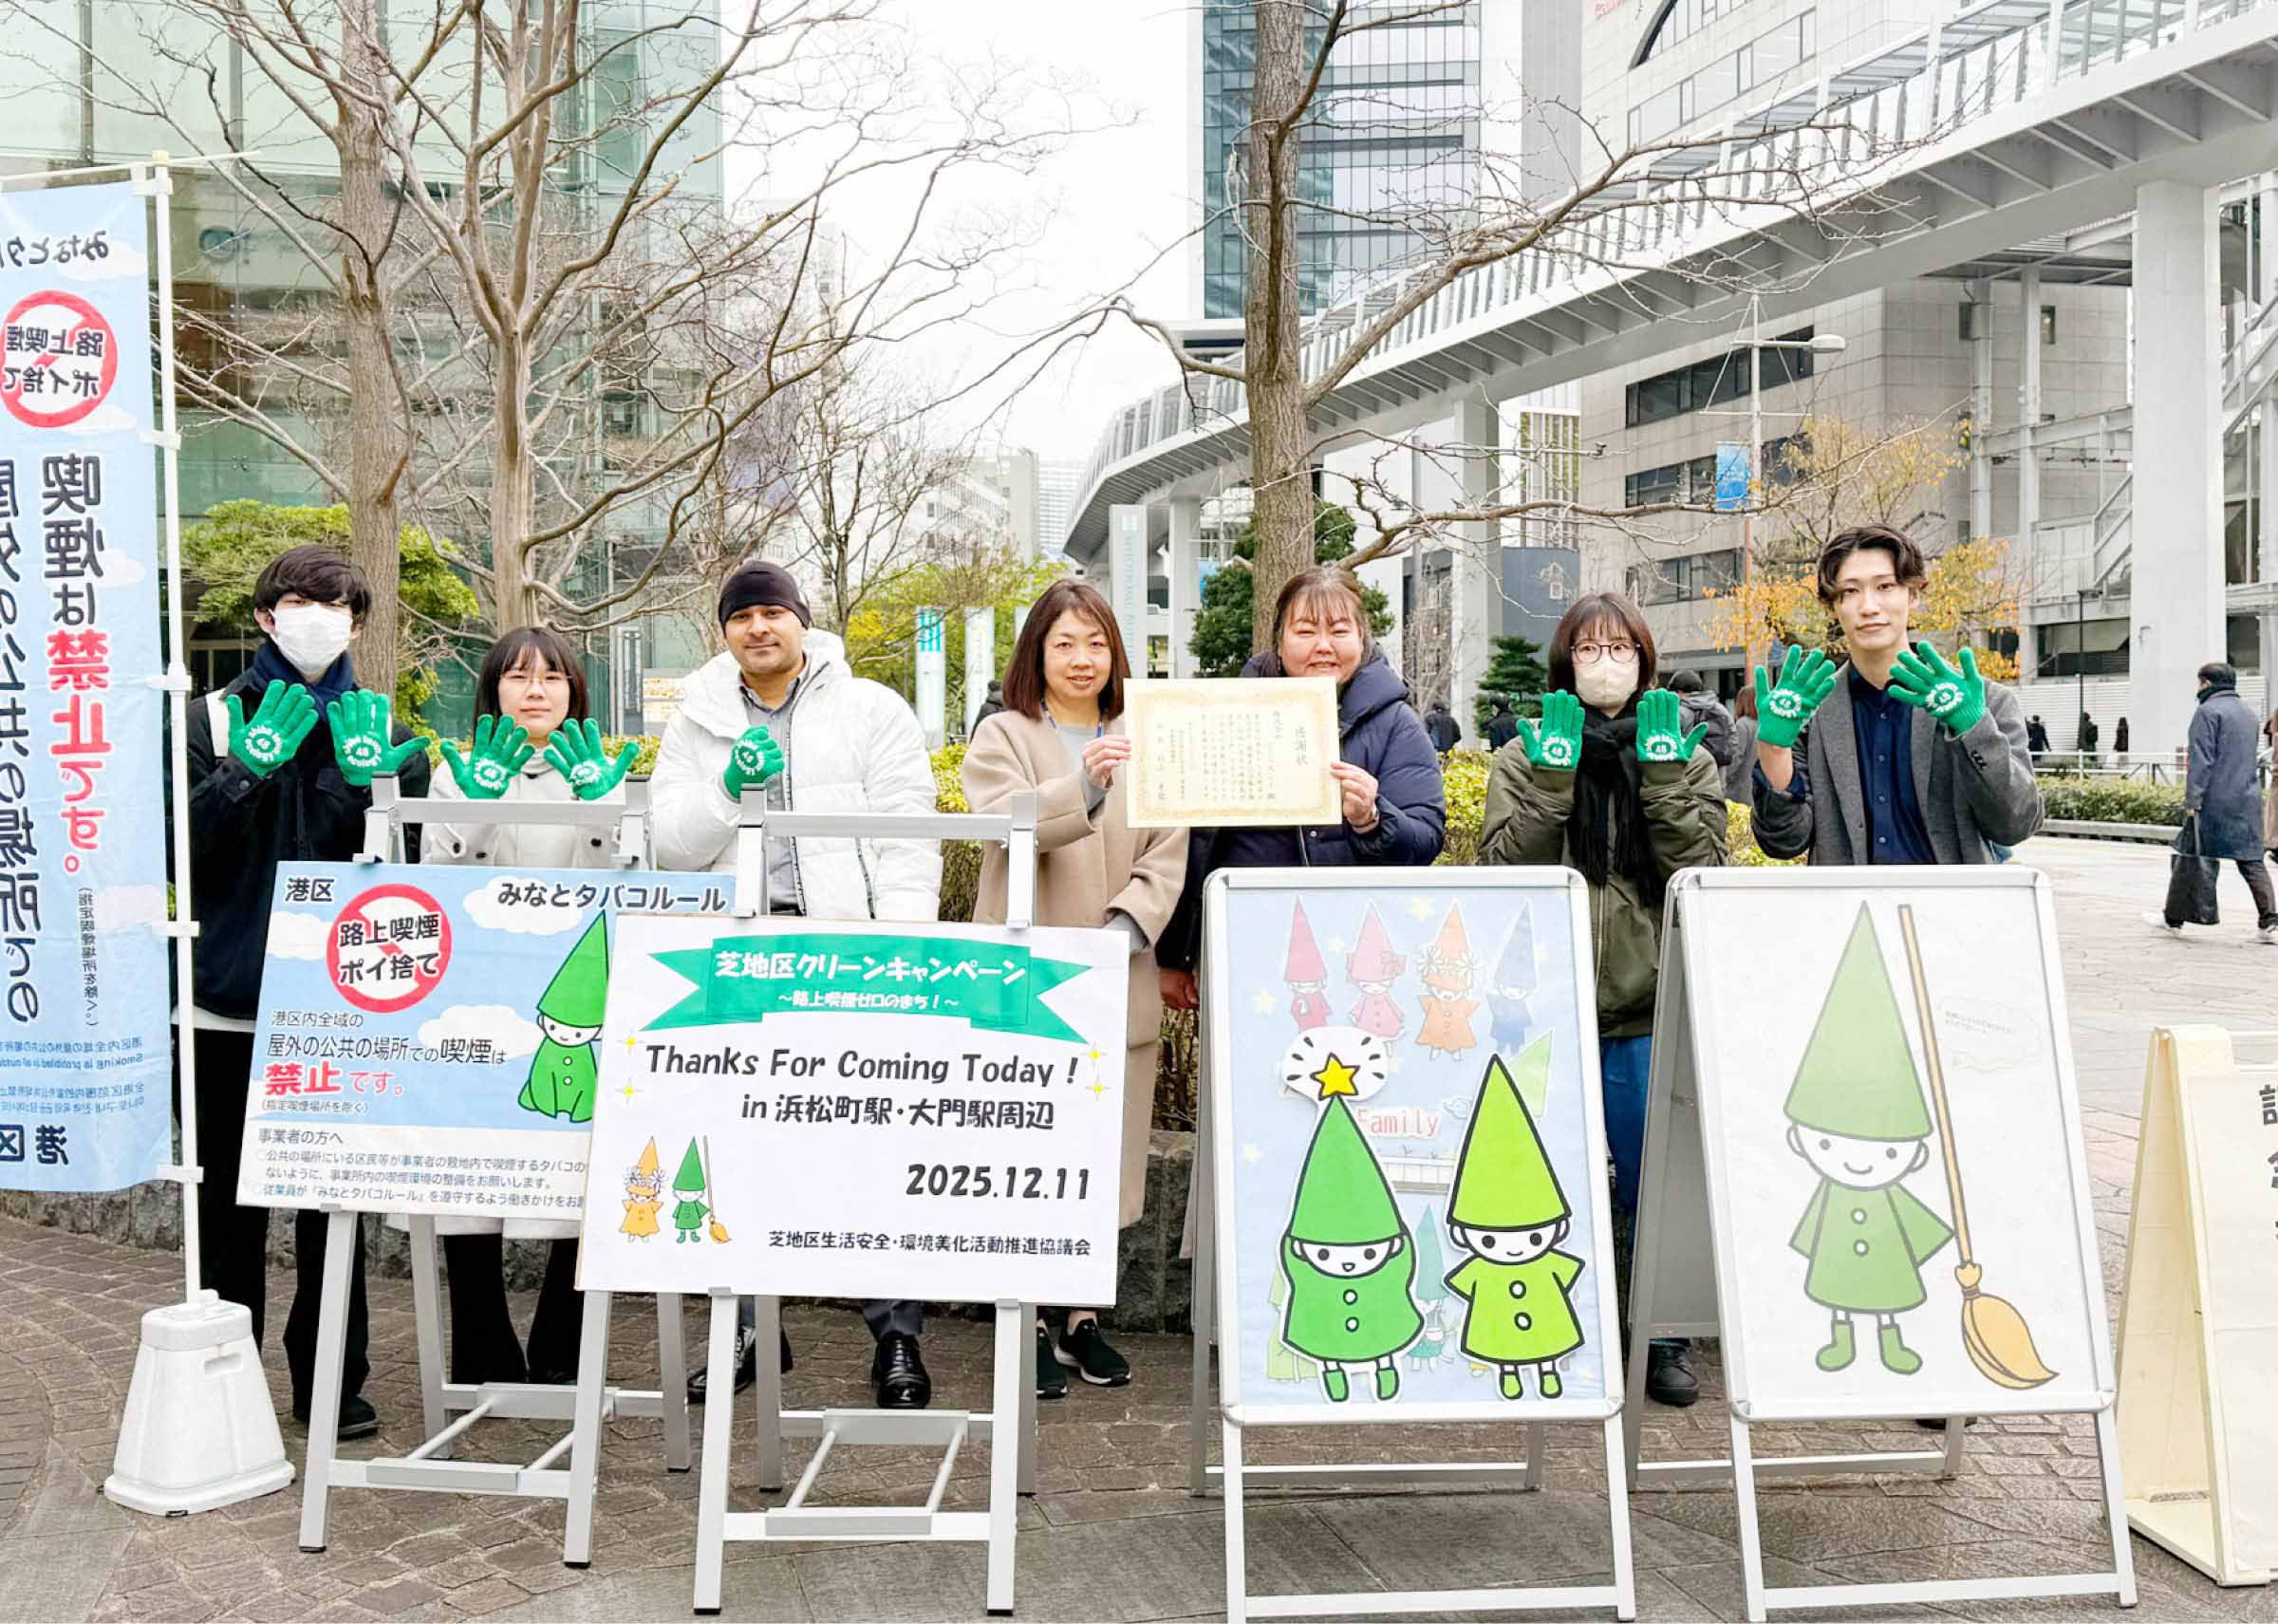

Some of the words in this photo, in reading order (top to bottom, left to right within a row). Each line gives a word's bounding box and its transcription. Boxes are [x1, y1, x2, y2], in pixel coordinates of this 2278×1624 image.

[284, 877, 336, 904] 港区
[496, 881, 727, 913] みなとタバコルール
[339, 913, 440, 948] 路上喫煙
[339, 950, 440, 985] ポイ捨て
[714, 950, 1028, 986] 芝地区クリーンキャンペーン
[271, 1010, 364, 1030] 港区内全域の
[267, 1033, 508, 1066] 屋外の公共の場所での喫煙は
[644, 1044, 759, 1077] Thanks
[769, 1048, 826, 1079] For
[836, 1050, 950, 1086] Coming
[962, 1053, 1055, 1088] Today
[264, 1061, 405, 1097] 禁止です。
[741, 1093, 767, 1120] in
[775, 1093, 1055, 1130] 浜松町駅・大門駅周辺
[1357, 1108, 1441, 1138] Family
[258, 1127, 344, 1147] 事業者の方へ
[906, 1163, 1091, 1201] 2025.12.11
[767, 1229, 1092, 1258] 芝地区生活安全・環境美化活動推進協議会
